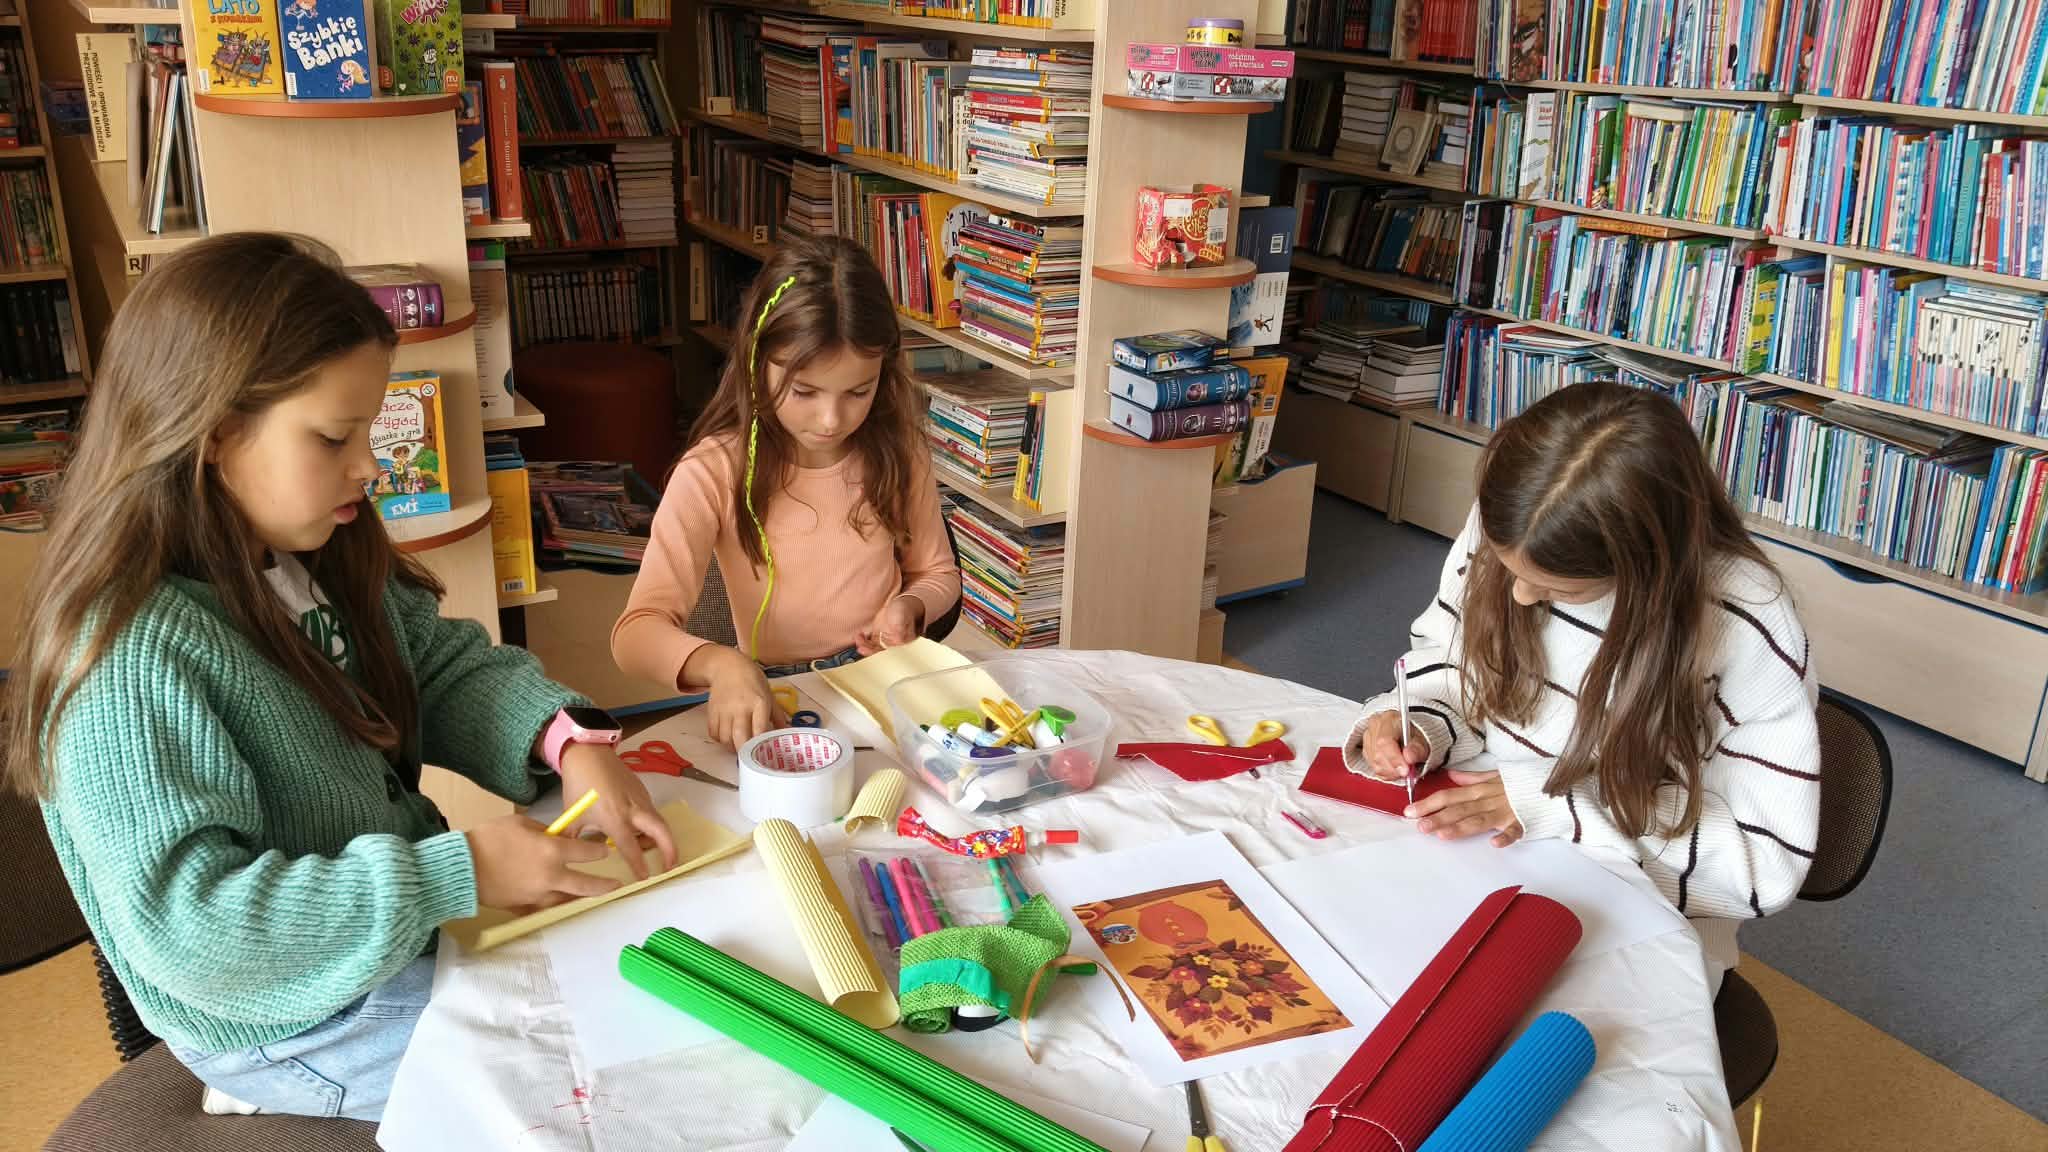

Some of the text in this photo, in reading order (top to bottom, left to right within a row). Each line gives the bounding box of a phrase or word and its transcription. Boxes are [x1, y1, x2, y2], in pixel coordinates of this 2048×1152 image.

[288, 17, 356, 49] Szybkie
[297, 30, 363, 70] Bańki
[83, 52, 96, 99] PRZYGODOWE
[91, 52, 103, 84] POWIEŚCI
[98, 91, 112, 138] OPOWIADANIA
[129, 258, 143, 271] R
[374, 413, 419, 430] zygód
[382, 402, 415, 412] acze
